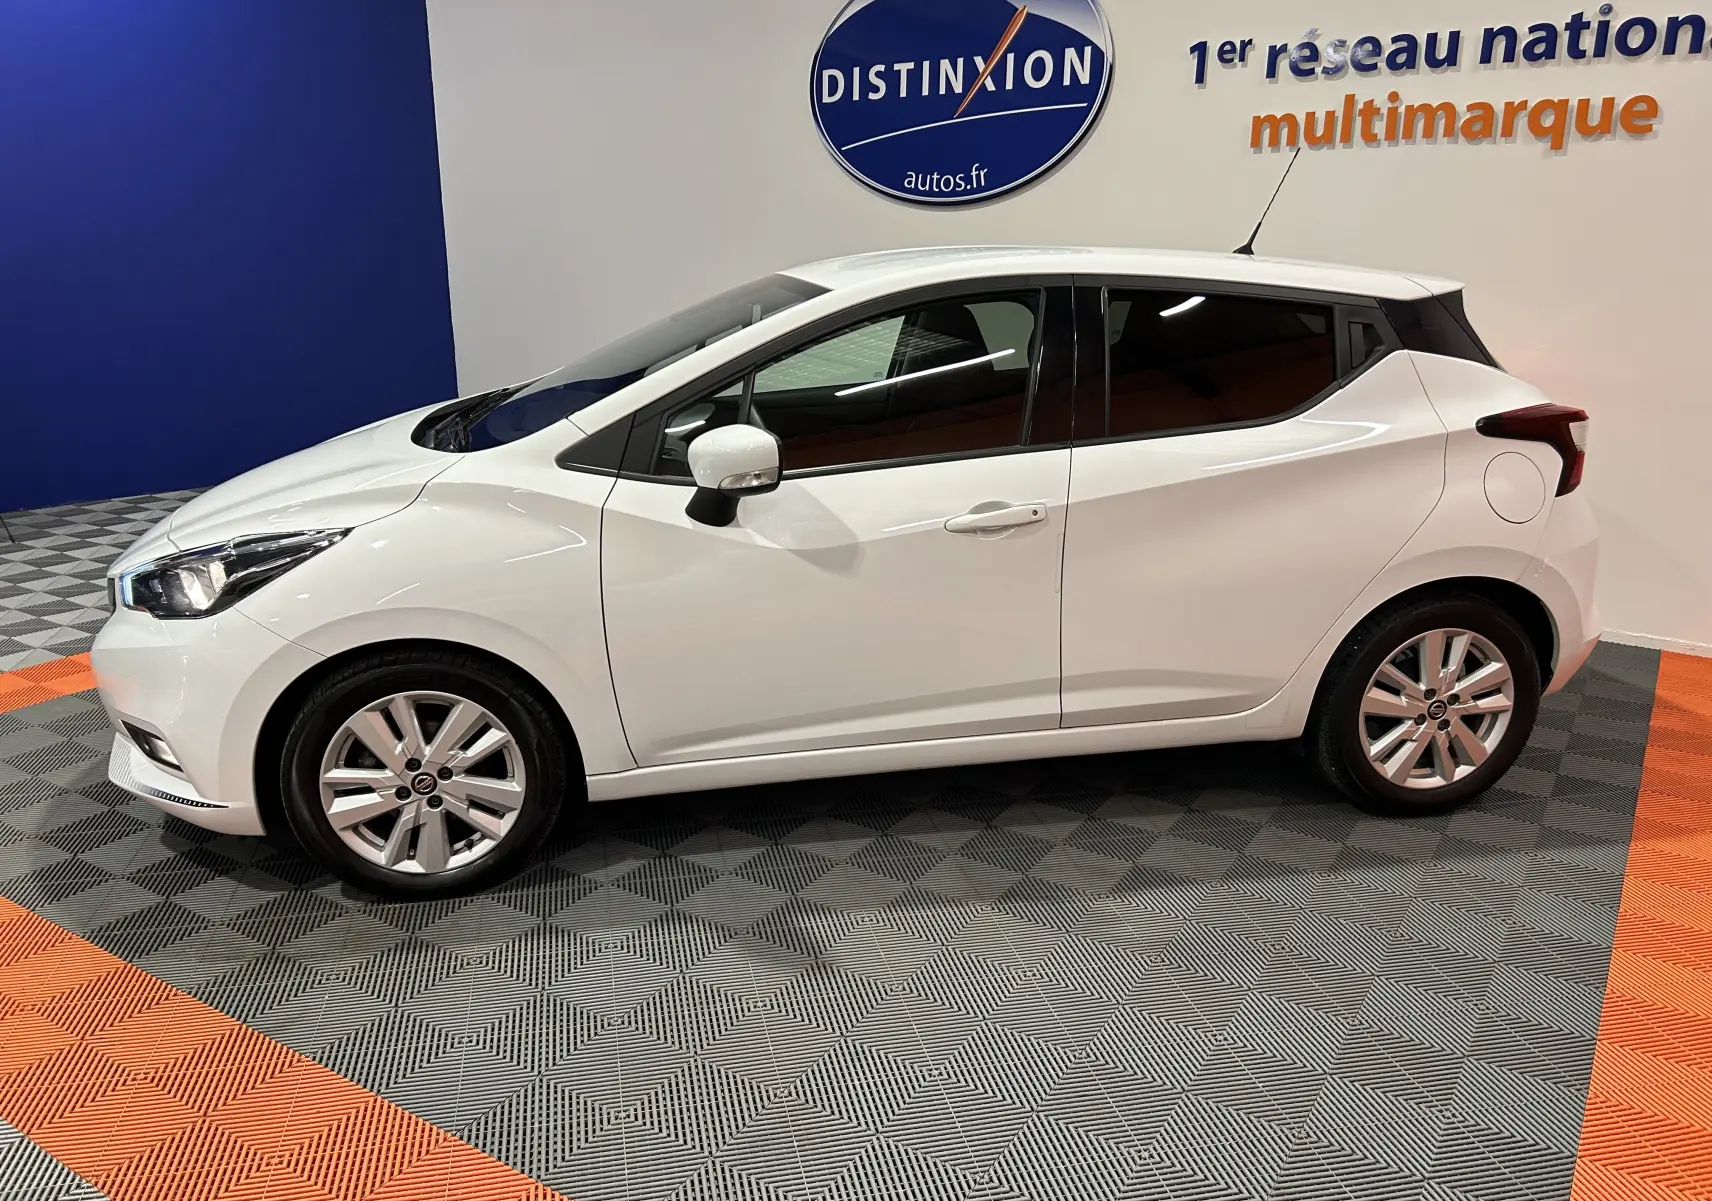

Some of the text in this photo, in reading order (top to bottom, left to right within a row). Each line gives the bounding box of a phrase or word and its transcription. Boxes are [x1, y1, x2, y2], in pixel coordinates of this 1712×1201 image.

[821, 45, 1093, 104] DISTINXION
[1189, 4, 1712, 85] 1er réseau nation
[1249, 90, 1660, 151] multimarque
[903, 162, 989, 192] autos.fr
